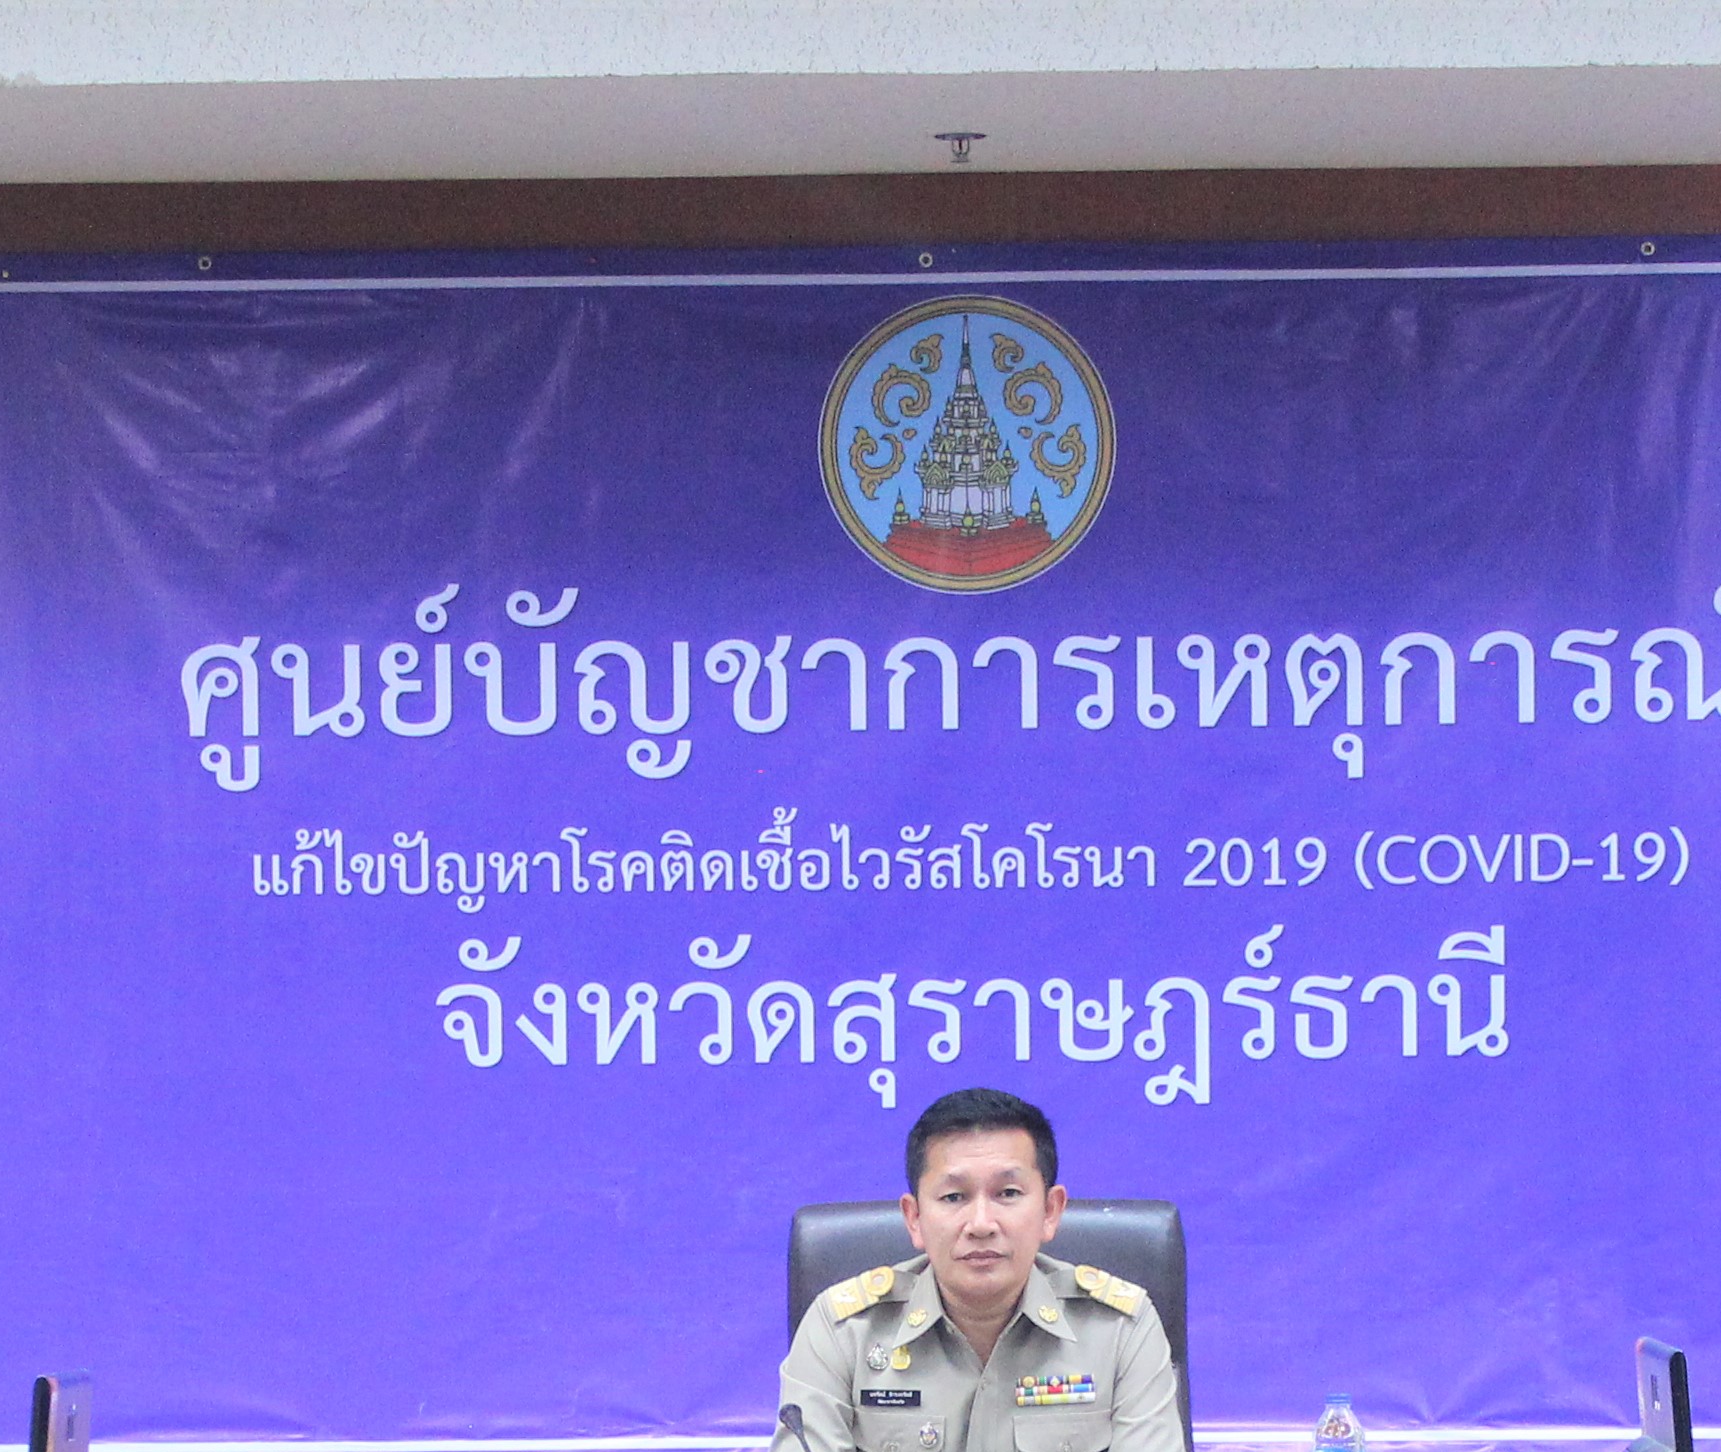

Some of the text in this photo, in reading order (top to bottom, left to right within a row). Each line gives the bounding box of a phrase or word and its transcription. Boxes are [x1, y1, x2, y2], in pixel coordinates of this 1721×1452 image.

[253, 805, 1690, 915] แก้ไขปัญหาโรคติดเชื้อไวรัสโคโรนา 2019 (COVID-19)
[434, 924, 1509, 1110] จังหวัดสุราษฎร์ธานี
